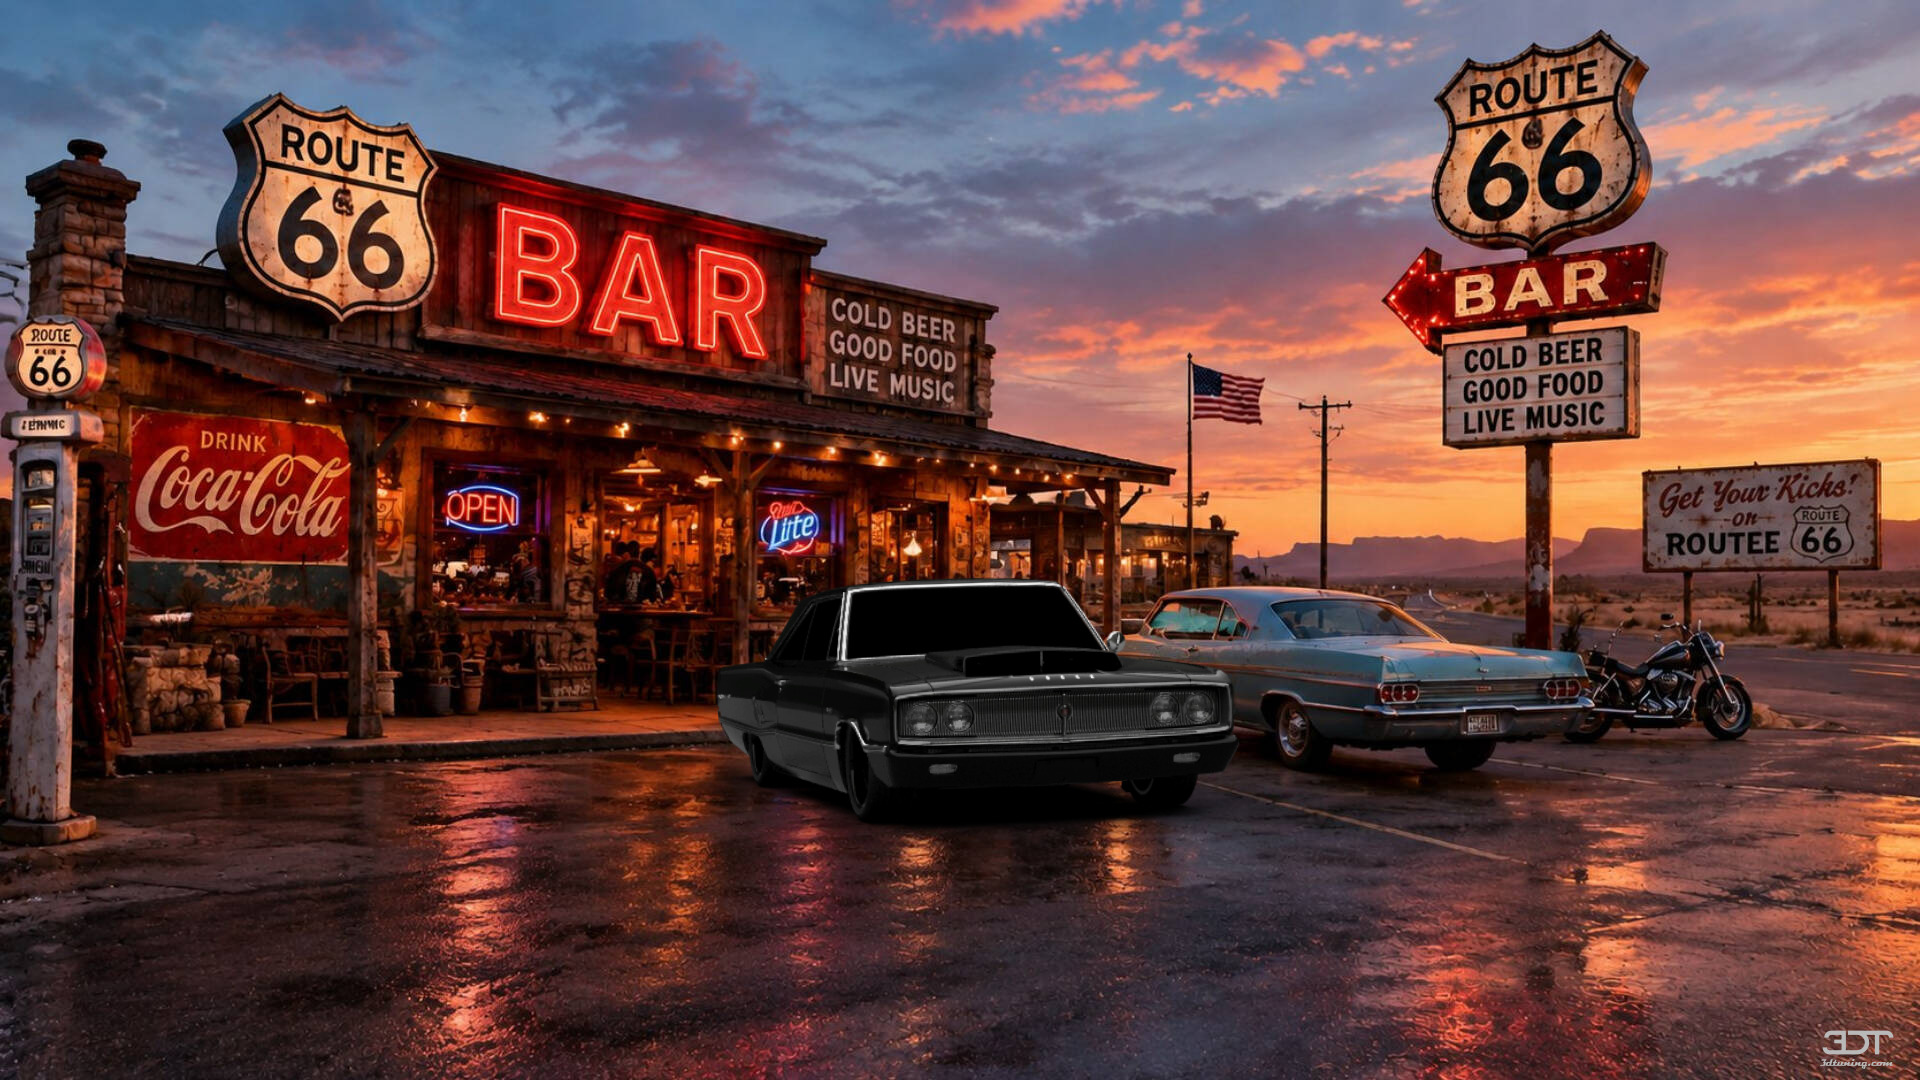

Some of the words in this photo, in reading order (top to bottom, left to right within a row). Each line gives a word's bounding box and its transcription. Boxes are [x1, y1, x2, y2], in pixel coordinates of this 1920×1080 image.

[1469, 59, 1598, 117] ROUTE
[281, 123, 405, 183] ROUTE
[1467, 117, 1603, 221] 66
[278, 185, 404, 290] 66
[494, 203, 769, 361] BAR
[1454, 259, 1609, 318] BAR
[31, 328, 72, 342] ROUTE
[831, 298, 892, 330] COLD
[902, 311, 956, 343] BEER
[829, 330, 893, 361] GOOD
[901, 343, 957, 373] FOOD
[1464, 346, 1527, 373] COLD
[1538, 338, 1602, 367] BEER
[29, 355, 71, 387] 66
[830, 362, 879, 393] LIVE
[890, 373, 955, 404] MUSIC
[1463, 376, 1527, 404] GOOD
[1538, 370, 1603, 399] FOOD
[1463, 408, 1515, 434] LIVE
[1525, 401, 1605, 430] MUSIC
[201, 430, 267, 453] DRINK
[135, 445, 352, 538] Coca-Cola
[447, 493, 516, 526] OPEN
[1658, 482, 1704, 518] Get
[1713, 478, 1770, 512] Your
[1775, 471, 1858, 503] Kicks!
[1732, 512, 1758, 527] on
[1802, 510, 1840, 521] ROUTE
[1665, 530, 1781, 556] ROUTEE
[1801, 526, 1842, 553] 66
